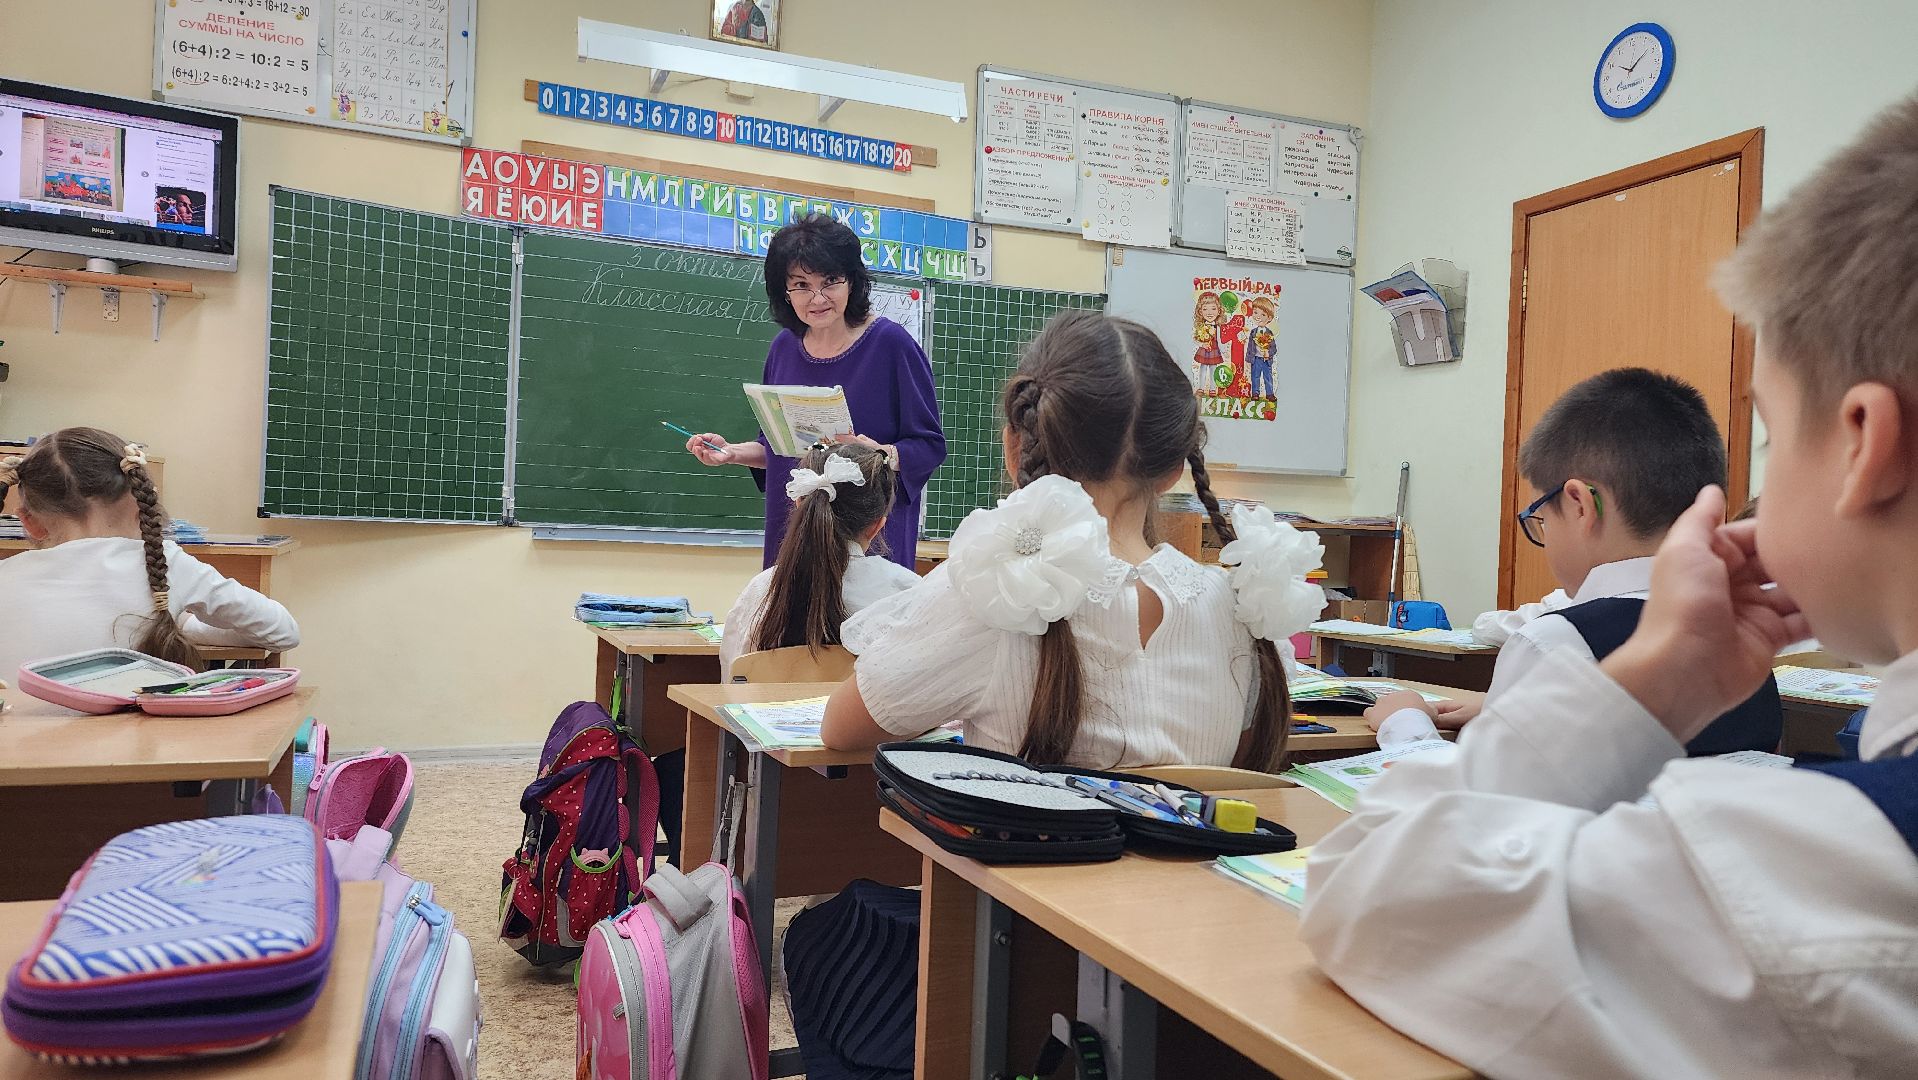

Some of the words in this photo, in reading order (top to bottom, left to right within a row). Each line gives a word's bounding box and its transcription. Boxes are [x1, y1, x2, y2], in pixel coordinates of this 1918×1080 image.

[206, 12, 275, 31] ДЕЛЕНИЕ
[298, 6, 310, 17] 30
[178, 20, 232, 36] СУММЫ
[236, 29, 255, 40] НА
[259, 32, 304, 46] ЧИСЛО
[250, 53, 281, 68] 10:2
[301, 60, 309, 72] 5
[302, 86, 308, 97] 5
[1001, 86, 1035, 99] ЧАСТИ
[1038, 92, 1064, 104] РЕЧИ
[1089, 108, 1133, 122] ПРАВИЛА
[1134, 115, 1165, 127] КОРНЯ
[542, 88, 554, 110] 0
[562, 91, 571, 112] 1
[580, 94, 590, 115] 2
[598, 96, 609, 118] 3
[616, 100, 627, 121] 4
[634, 102, 644, 124] 5
[652, 106, 663, 127] 6
[670, 108, 680, 130] 7
[686, 111, 697, 133] 8
[704, 114, 714, 135] 9
[718, 117, 734, 139] 10
[737, 120, 752, 141] 11
[756, 122, 772, 144] 12
[774, 126, 789, 147] 13
[792, 128, 808, 151] 14
[810, 132, 826, 154] 15
[828, 135, 843, 157] 16
[846, 138, 861, 160] 17
[862, 141, 878, 163] 18
[880, 144, 894, 165] 19
[895, 148, 912, 168] 20
[464, 152, 489, 181] А
[493, 155, 519, 184] О
[524, 158, 547, 187] У
[552, 164, 575, 192] Ы
[582, 168, 601, 195] Э
[607, 170, 628, 199] Н
[631, 175, 657, 203] М
[660, 180, 679, 207] Л
[690, 183, 705, 209] Р
[713, 186, 735, 214] Й
[738, 194, 753, 218] Б
[763, 196, 778, 223] В
[860, 211, 876, 236] З
[92, 227, 115, 235] PHILIPS
[466, 187, 484, 214] Я
[496, 186, 513, 218] Ё
[521, 194, 548, 223] Ю
[550, 198, 572, 226] И
[582, 202, 598, 229] Е
[739, 224, 753, 250] П
[860, 242, 875, 267] С
[882, 244, 898, 269] Х
[904, 248, 920, 275] Ц
[926, 252, 941, 275] Ч
[946, 254, 968, 281] Щ
[973, 228, 987, 249] Ь
[627, 246, 642, 268] 3
[654, 251, 766, 292] октябр
[970, 258, 986, 277] Ъ
[582, 262, 737, 319] Классная
[1194, 276, 1252, 293] ПЕРВЫЙ
[1256, 282, 1281, 296] РА
[1201, 398, 1266, 418] КЛАСС
